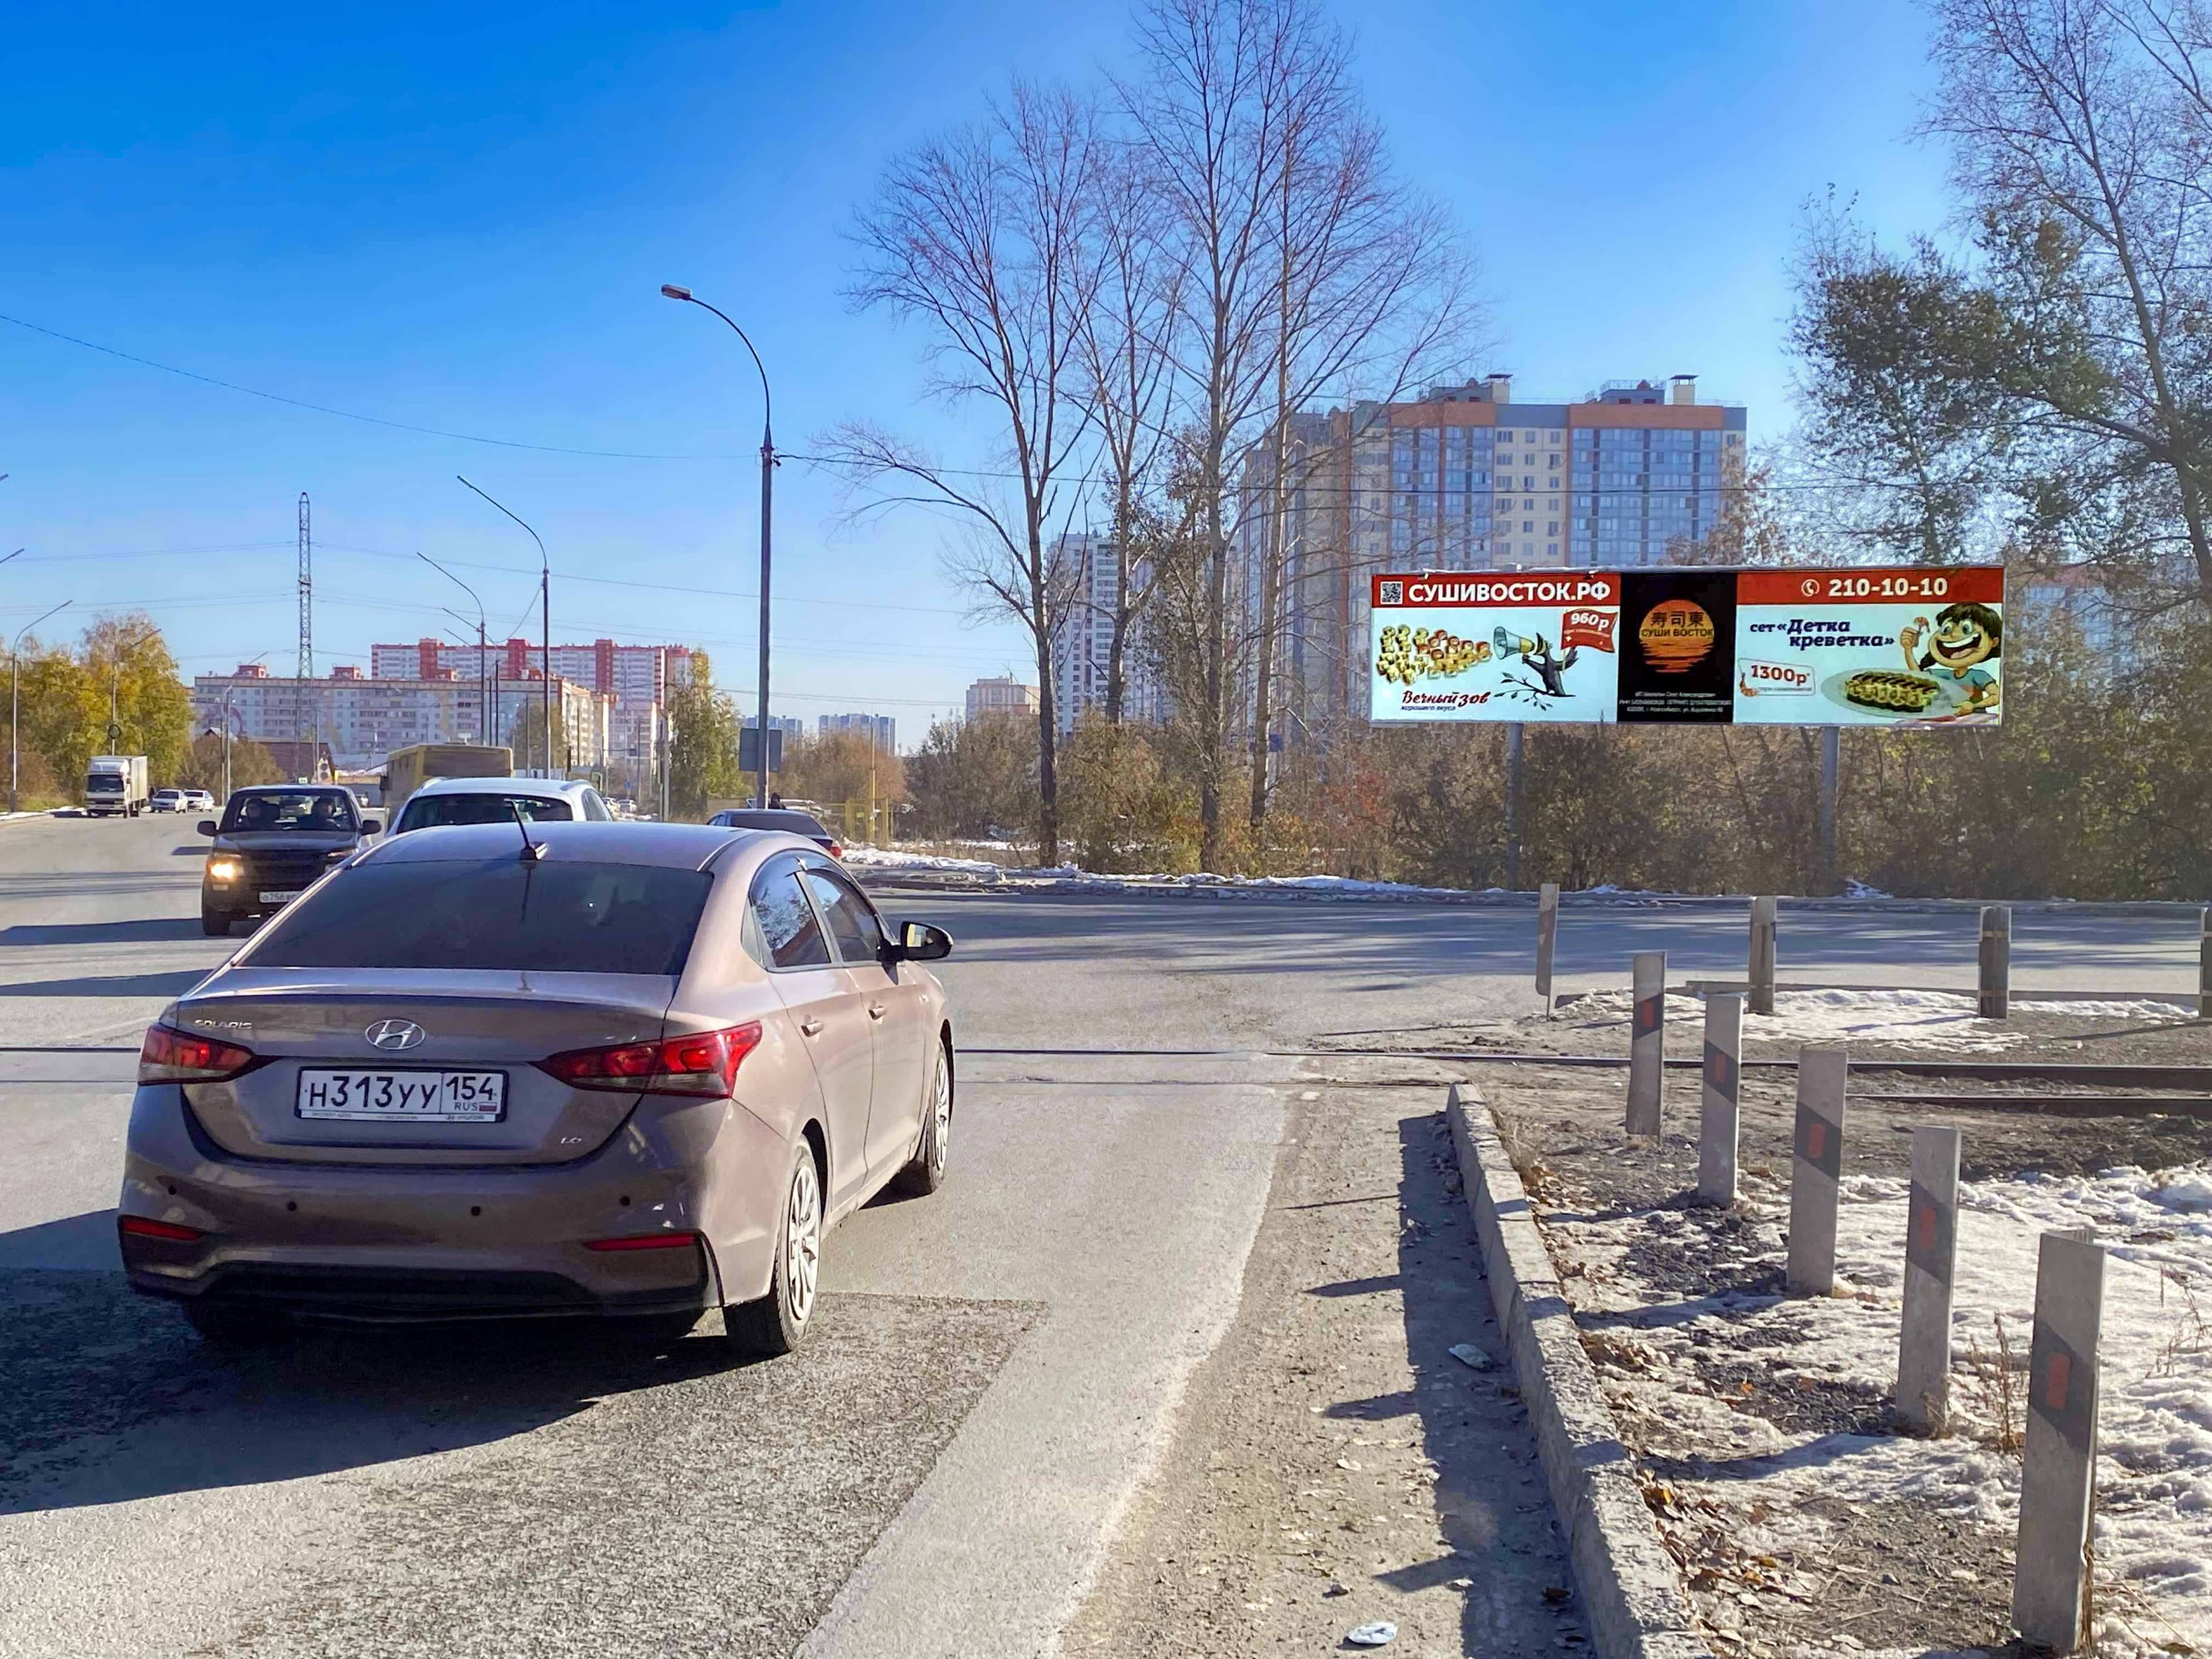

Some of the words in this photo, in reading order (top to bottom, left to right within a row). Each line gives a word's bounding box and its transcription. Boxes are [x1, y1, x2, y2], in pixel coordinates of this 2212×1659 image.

[1408, 581, 1611, 602] СУШИВОСТОК.РФ
[1828, 578, 1948, 597] 210-10-10
[1641, 628, 1671, 637] СУШИ
[1673, 628, 1714, 637] ВОСТОК
[1789, 635, 1895, 651] креветка»
[1402, 690, 1460, 704] Вечный
[1457, 691, 1491, 708] зов
[194, 1019, 253, 1030] SOLARIS
[309, 1075, 438, 1109] Н313УУ
[446, 1076, 494, 1101] 154
[454, 1101, 478, 1111] RUS
